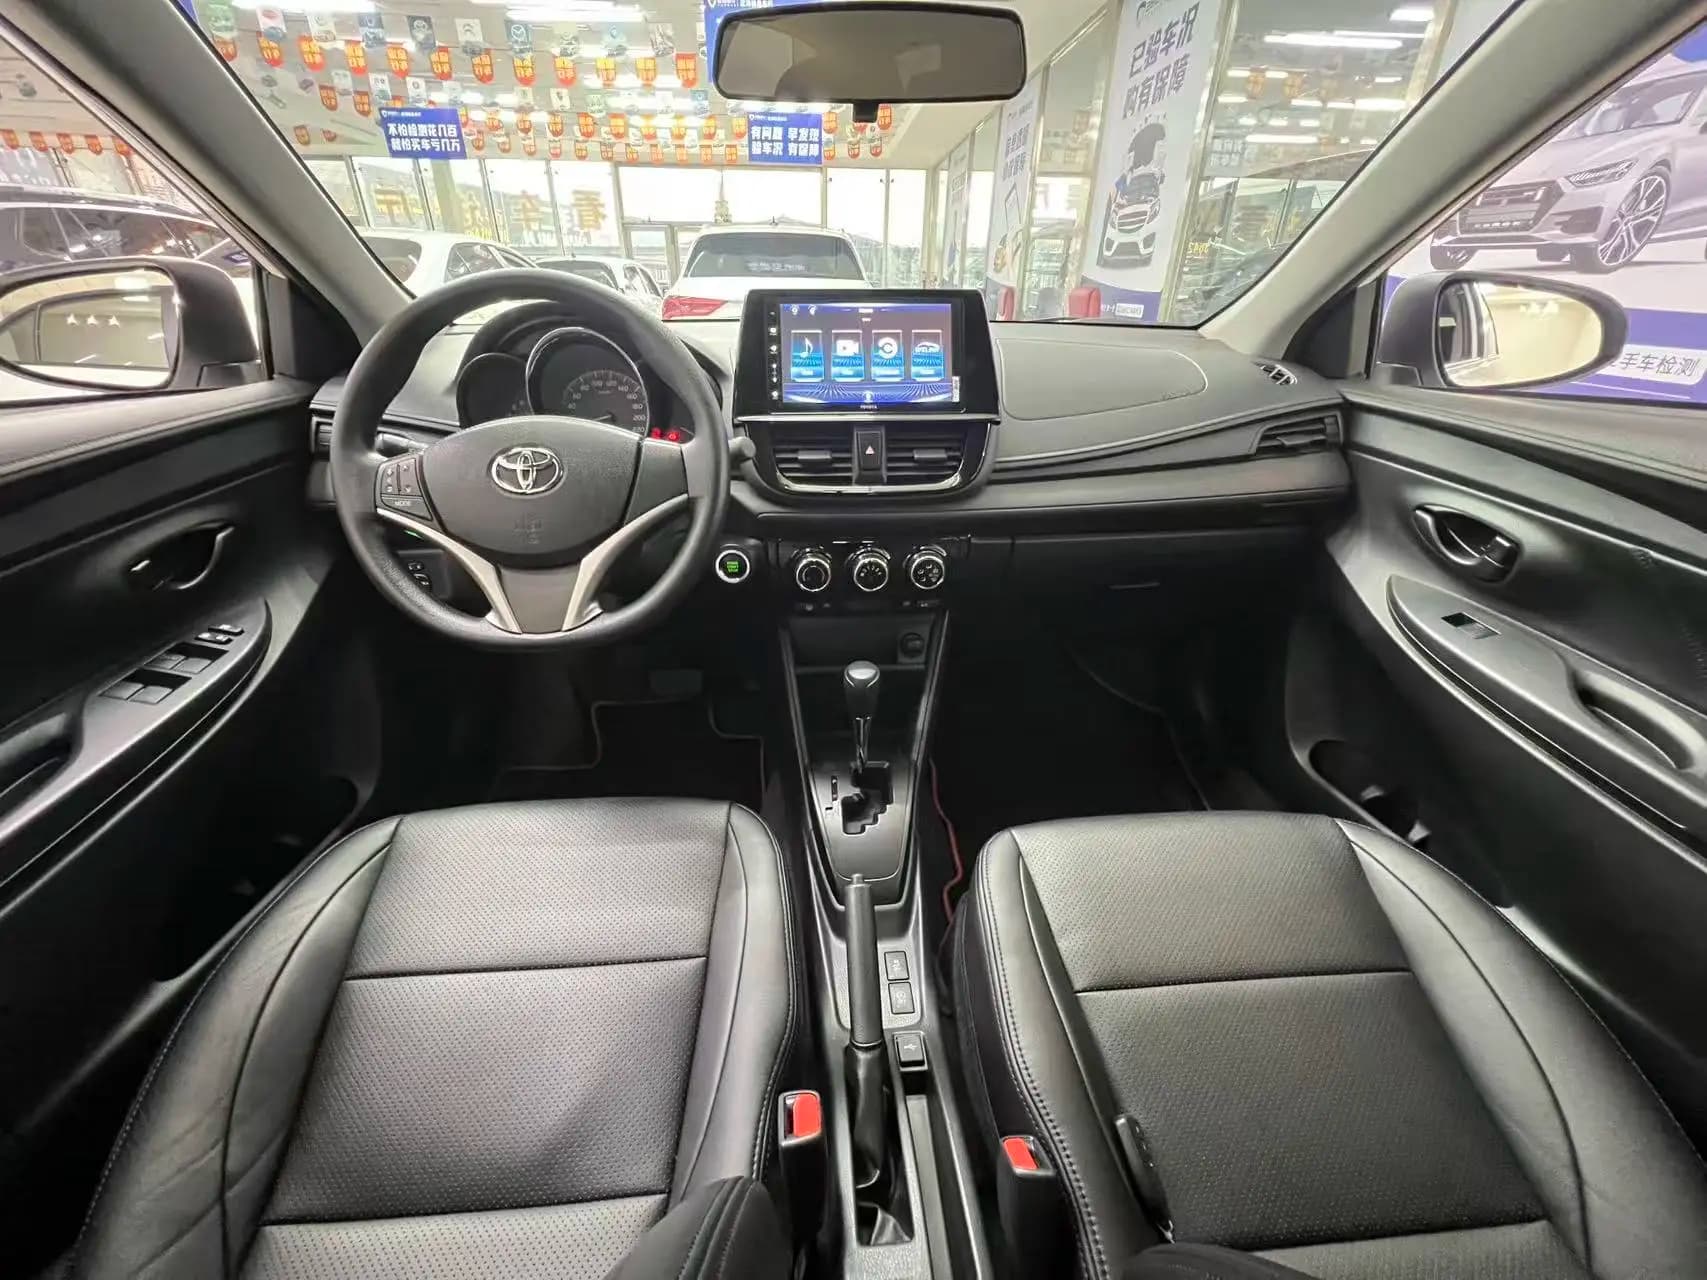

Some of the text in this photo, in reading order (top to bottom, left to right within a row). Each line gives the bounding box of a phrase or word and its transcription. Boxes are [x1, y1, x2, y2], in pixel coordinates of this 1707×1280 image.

[391, 137, 461, 152] 就怕买车亏几万
[1611, 352, 1700, 377] 手车检测
